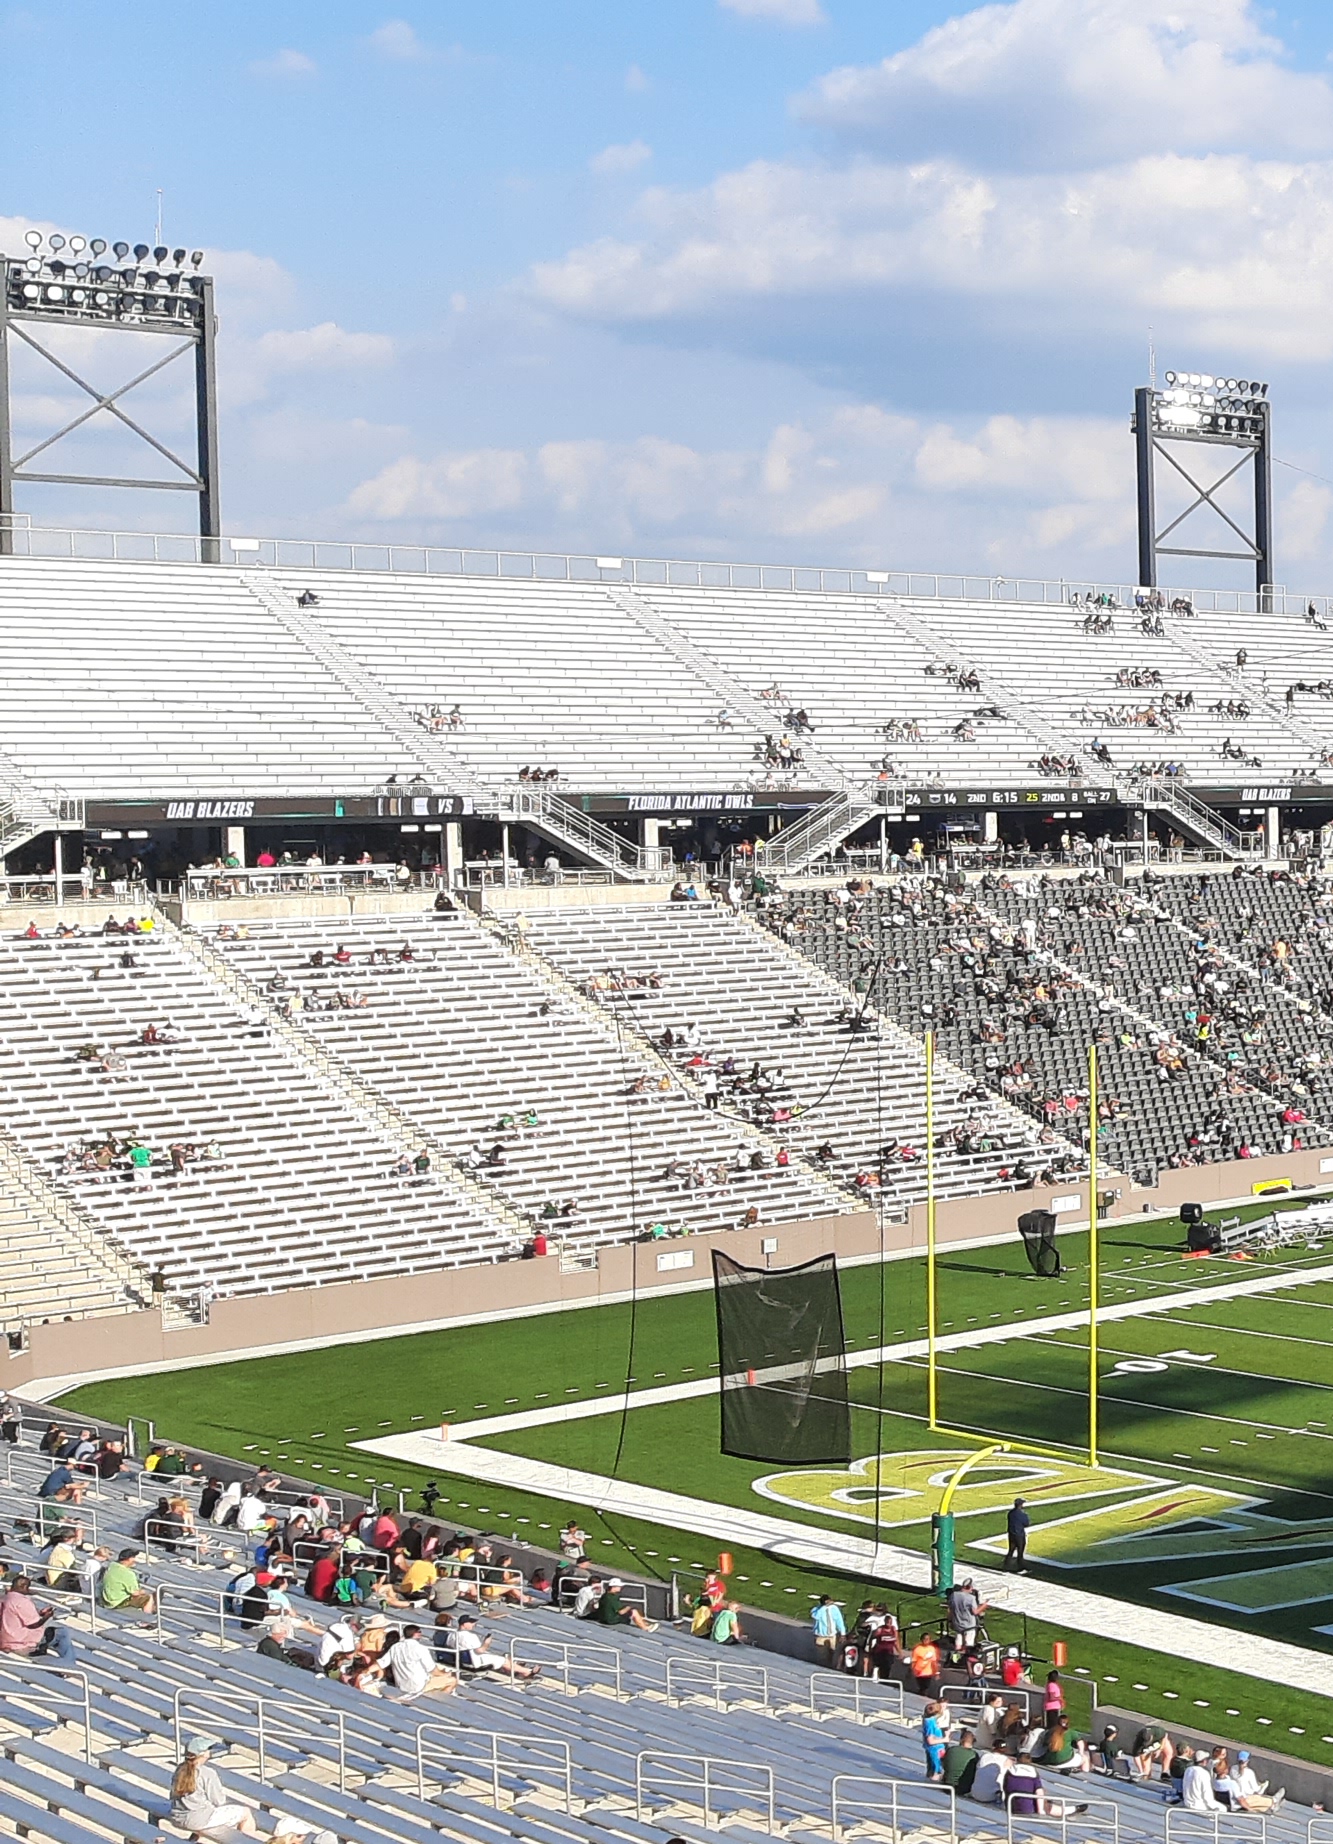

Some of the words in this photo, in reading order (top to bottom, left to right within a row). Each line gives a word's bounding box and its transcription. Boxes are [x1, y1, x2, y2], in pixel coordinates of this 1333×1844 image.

[906, 794, 921, 805] 24
[944, 793, 957, 804] 14
[967, 793, 987, 803] 2ND
[992, 792, 1018, 803] 6:15
[1026, 792, 1038, 802] 25
[1100, 792, 1110, 801] 27
[437, 799, 454, 814] VS
[628, 796, 671, 811] FLORIDA
[673, 795, 722, 810] ATLANTIC
[724, 794, 753, 809] OWLS
[196, 801, 254, 818] BLAZERS
[1114, 1349, 1218, 1373] 10
